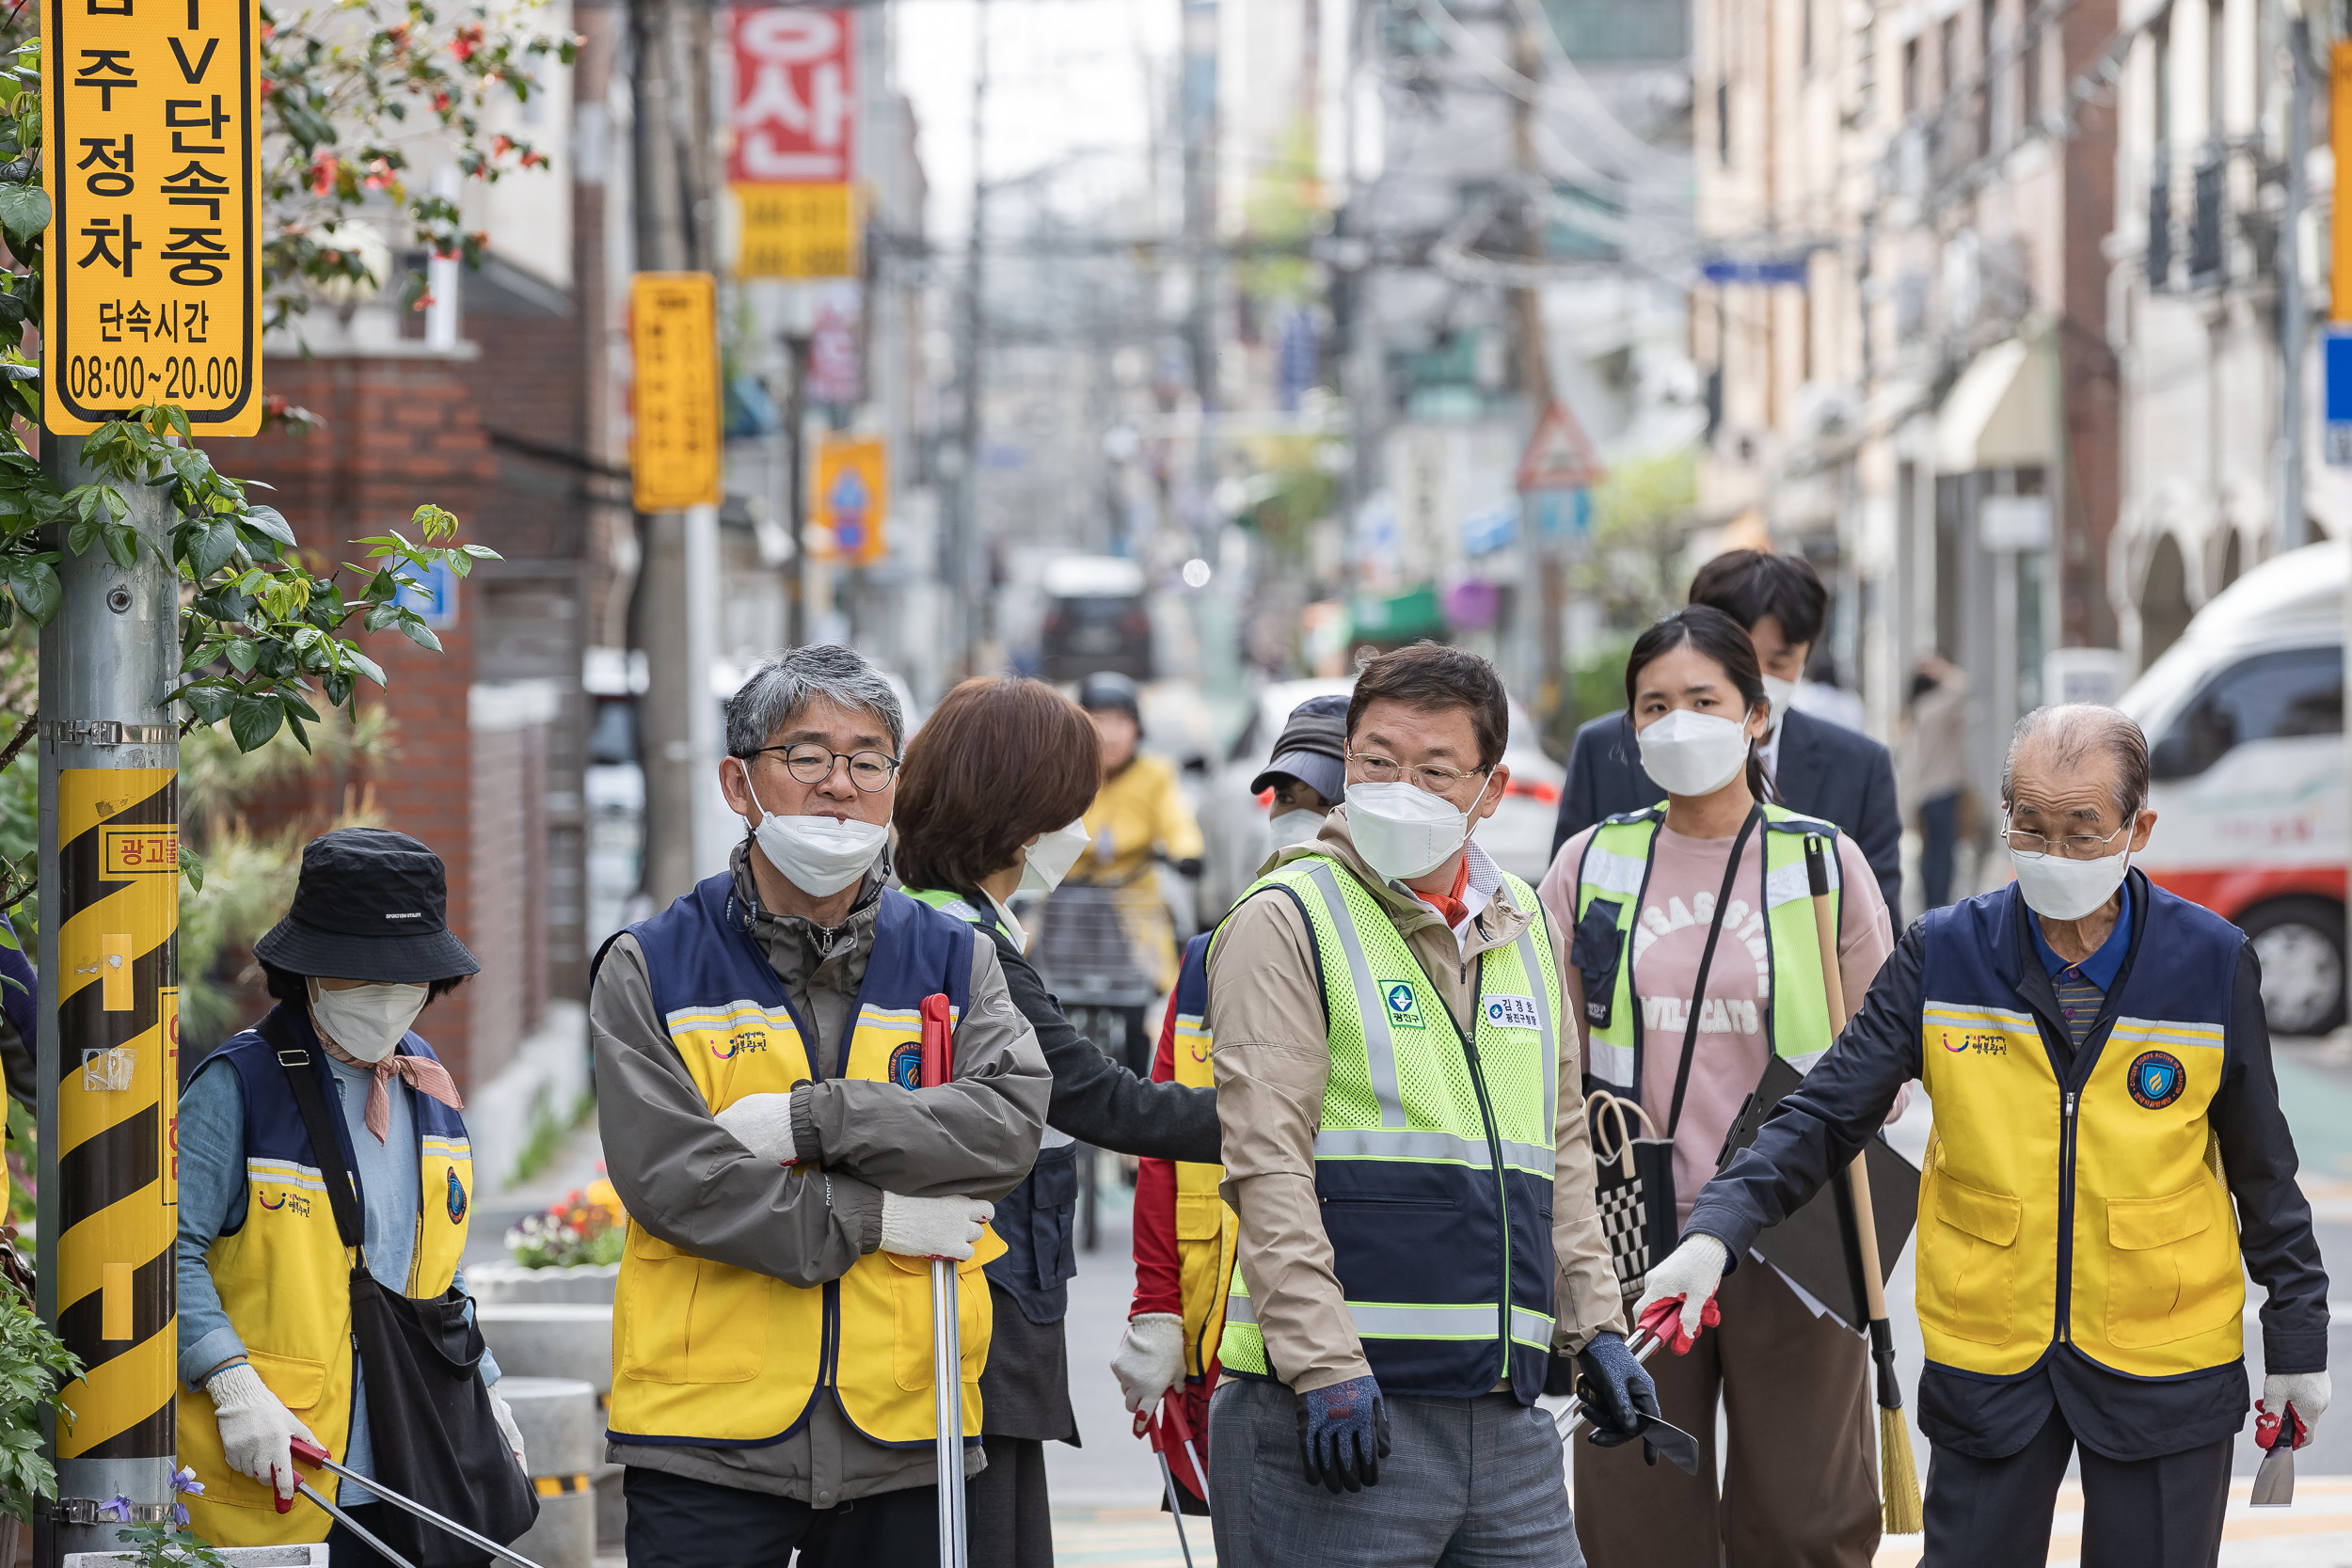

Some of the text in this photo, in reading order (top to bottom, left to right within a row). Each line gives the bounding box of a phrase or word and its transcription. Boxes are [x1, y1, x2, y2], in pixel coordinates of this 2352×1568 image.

[74, 0, 142, 277] 주정차
[100, 299, 209, 343] 단속시간
[71, 355, 238, 400] 08:00~20.00
[1392, 1013, 1420, 1023] 광진구
[894, 1044, 910, 1058] CORPS
[1972, 1041, 2007, 1055] 행복광진
[2154, 1053, 2174, 1064] ACTIVE
